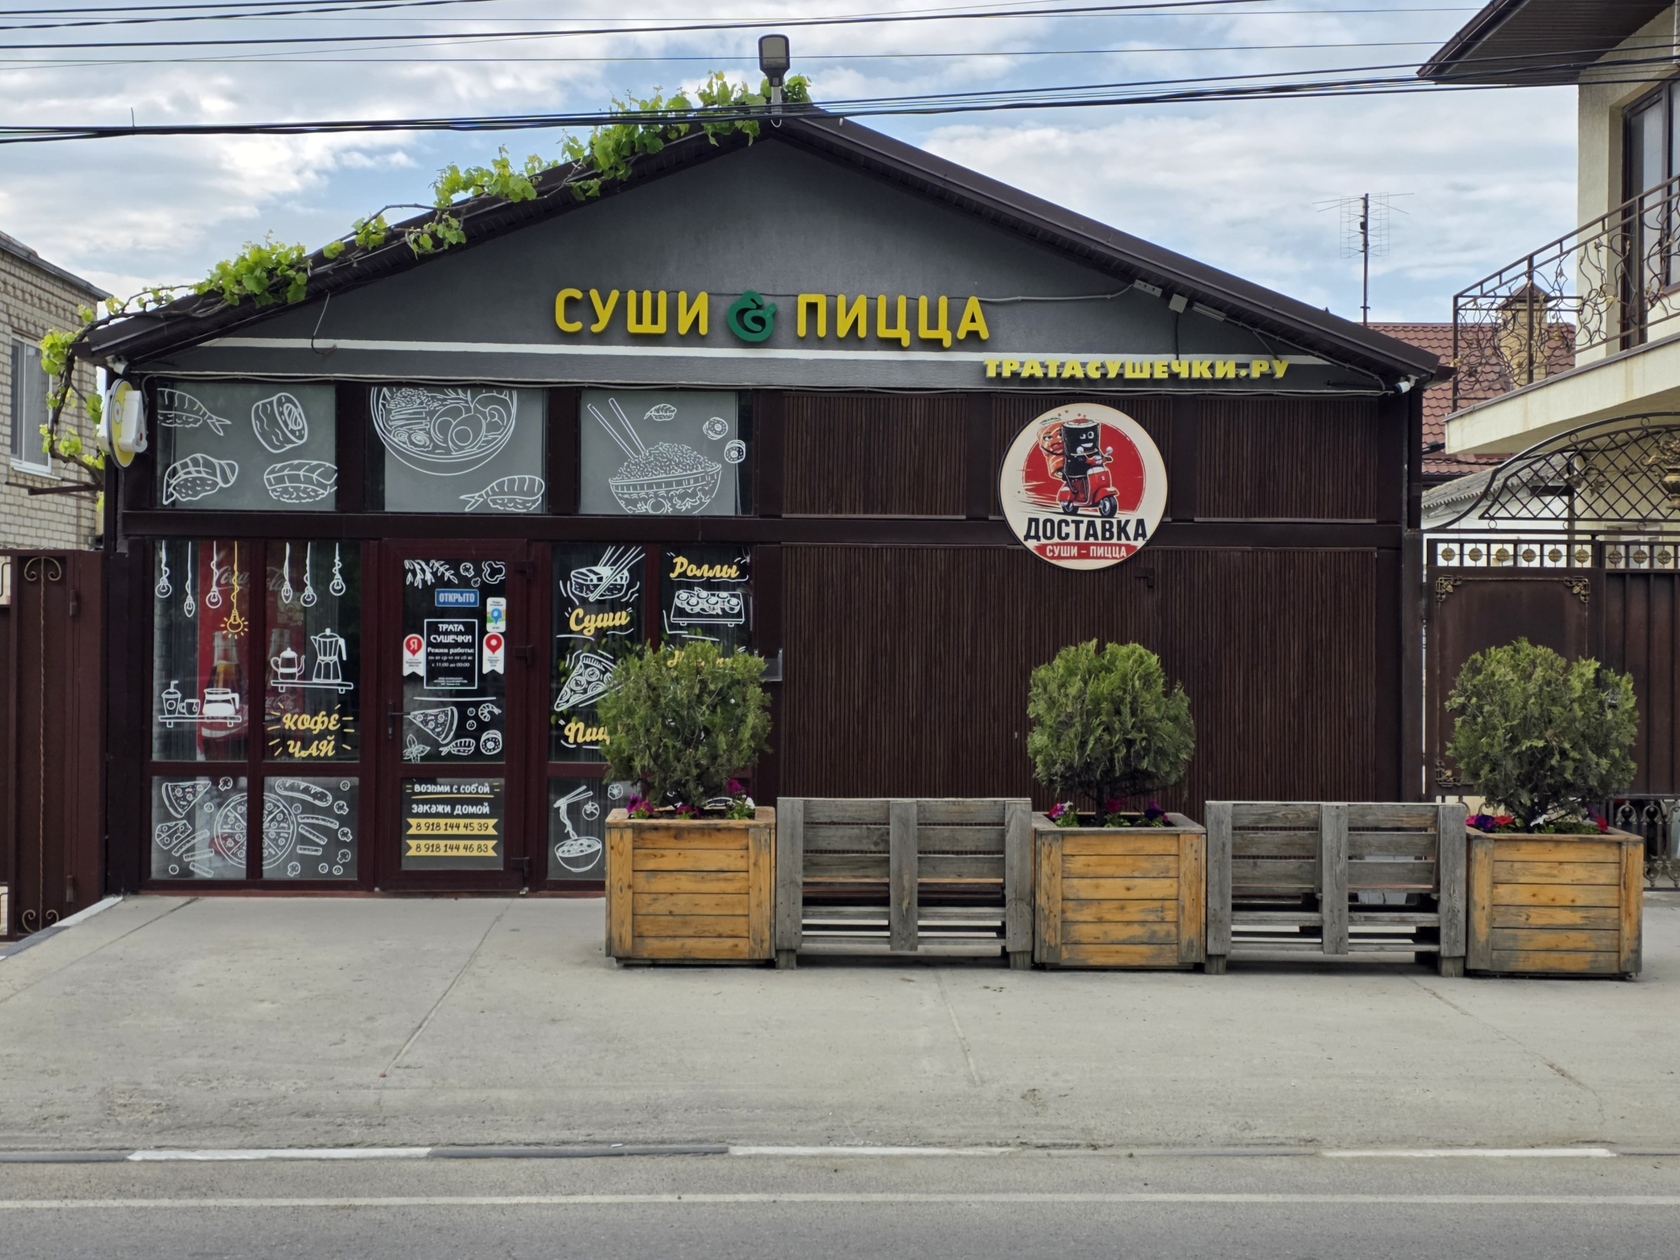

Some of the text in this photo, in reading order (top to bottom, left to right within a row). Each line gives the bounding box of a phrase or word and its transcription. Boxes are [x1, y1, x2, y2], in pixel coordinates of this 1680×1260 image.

[555, 288, 708, 336] СУШИ
[797, 293, 990, 348] ПИЦЦА
[984, 358, 1290, 379] ТРАТАСУШЕЧКИ.РУ
[1024, 517, 1148, 542] ДОСТАВКА
[1046, 545, 1078, 557] СУШИ
[1090, 546, 1127, 559] ПИЦЦА
[669, 556, 741, 579] Роллы
[439, 592, 475, 603] ОТКРЫТО
[438, 624, 465, 632] ТРАТА
[569, 608, 631, 636] Суши
[409, 639, 418, 650] Я
[430, 635, 472, 643] СУШЕЧКИ
[414, 782, 490, 793] возьми с собой
[411, 802, 490, 815] закажи домой
[415, 822, 489, 832] 8 918 144 45 39
[415, 843, 489, 853] 8 918 144 46 83
